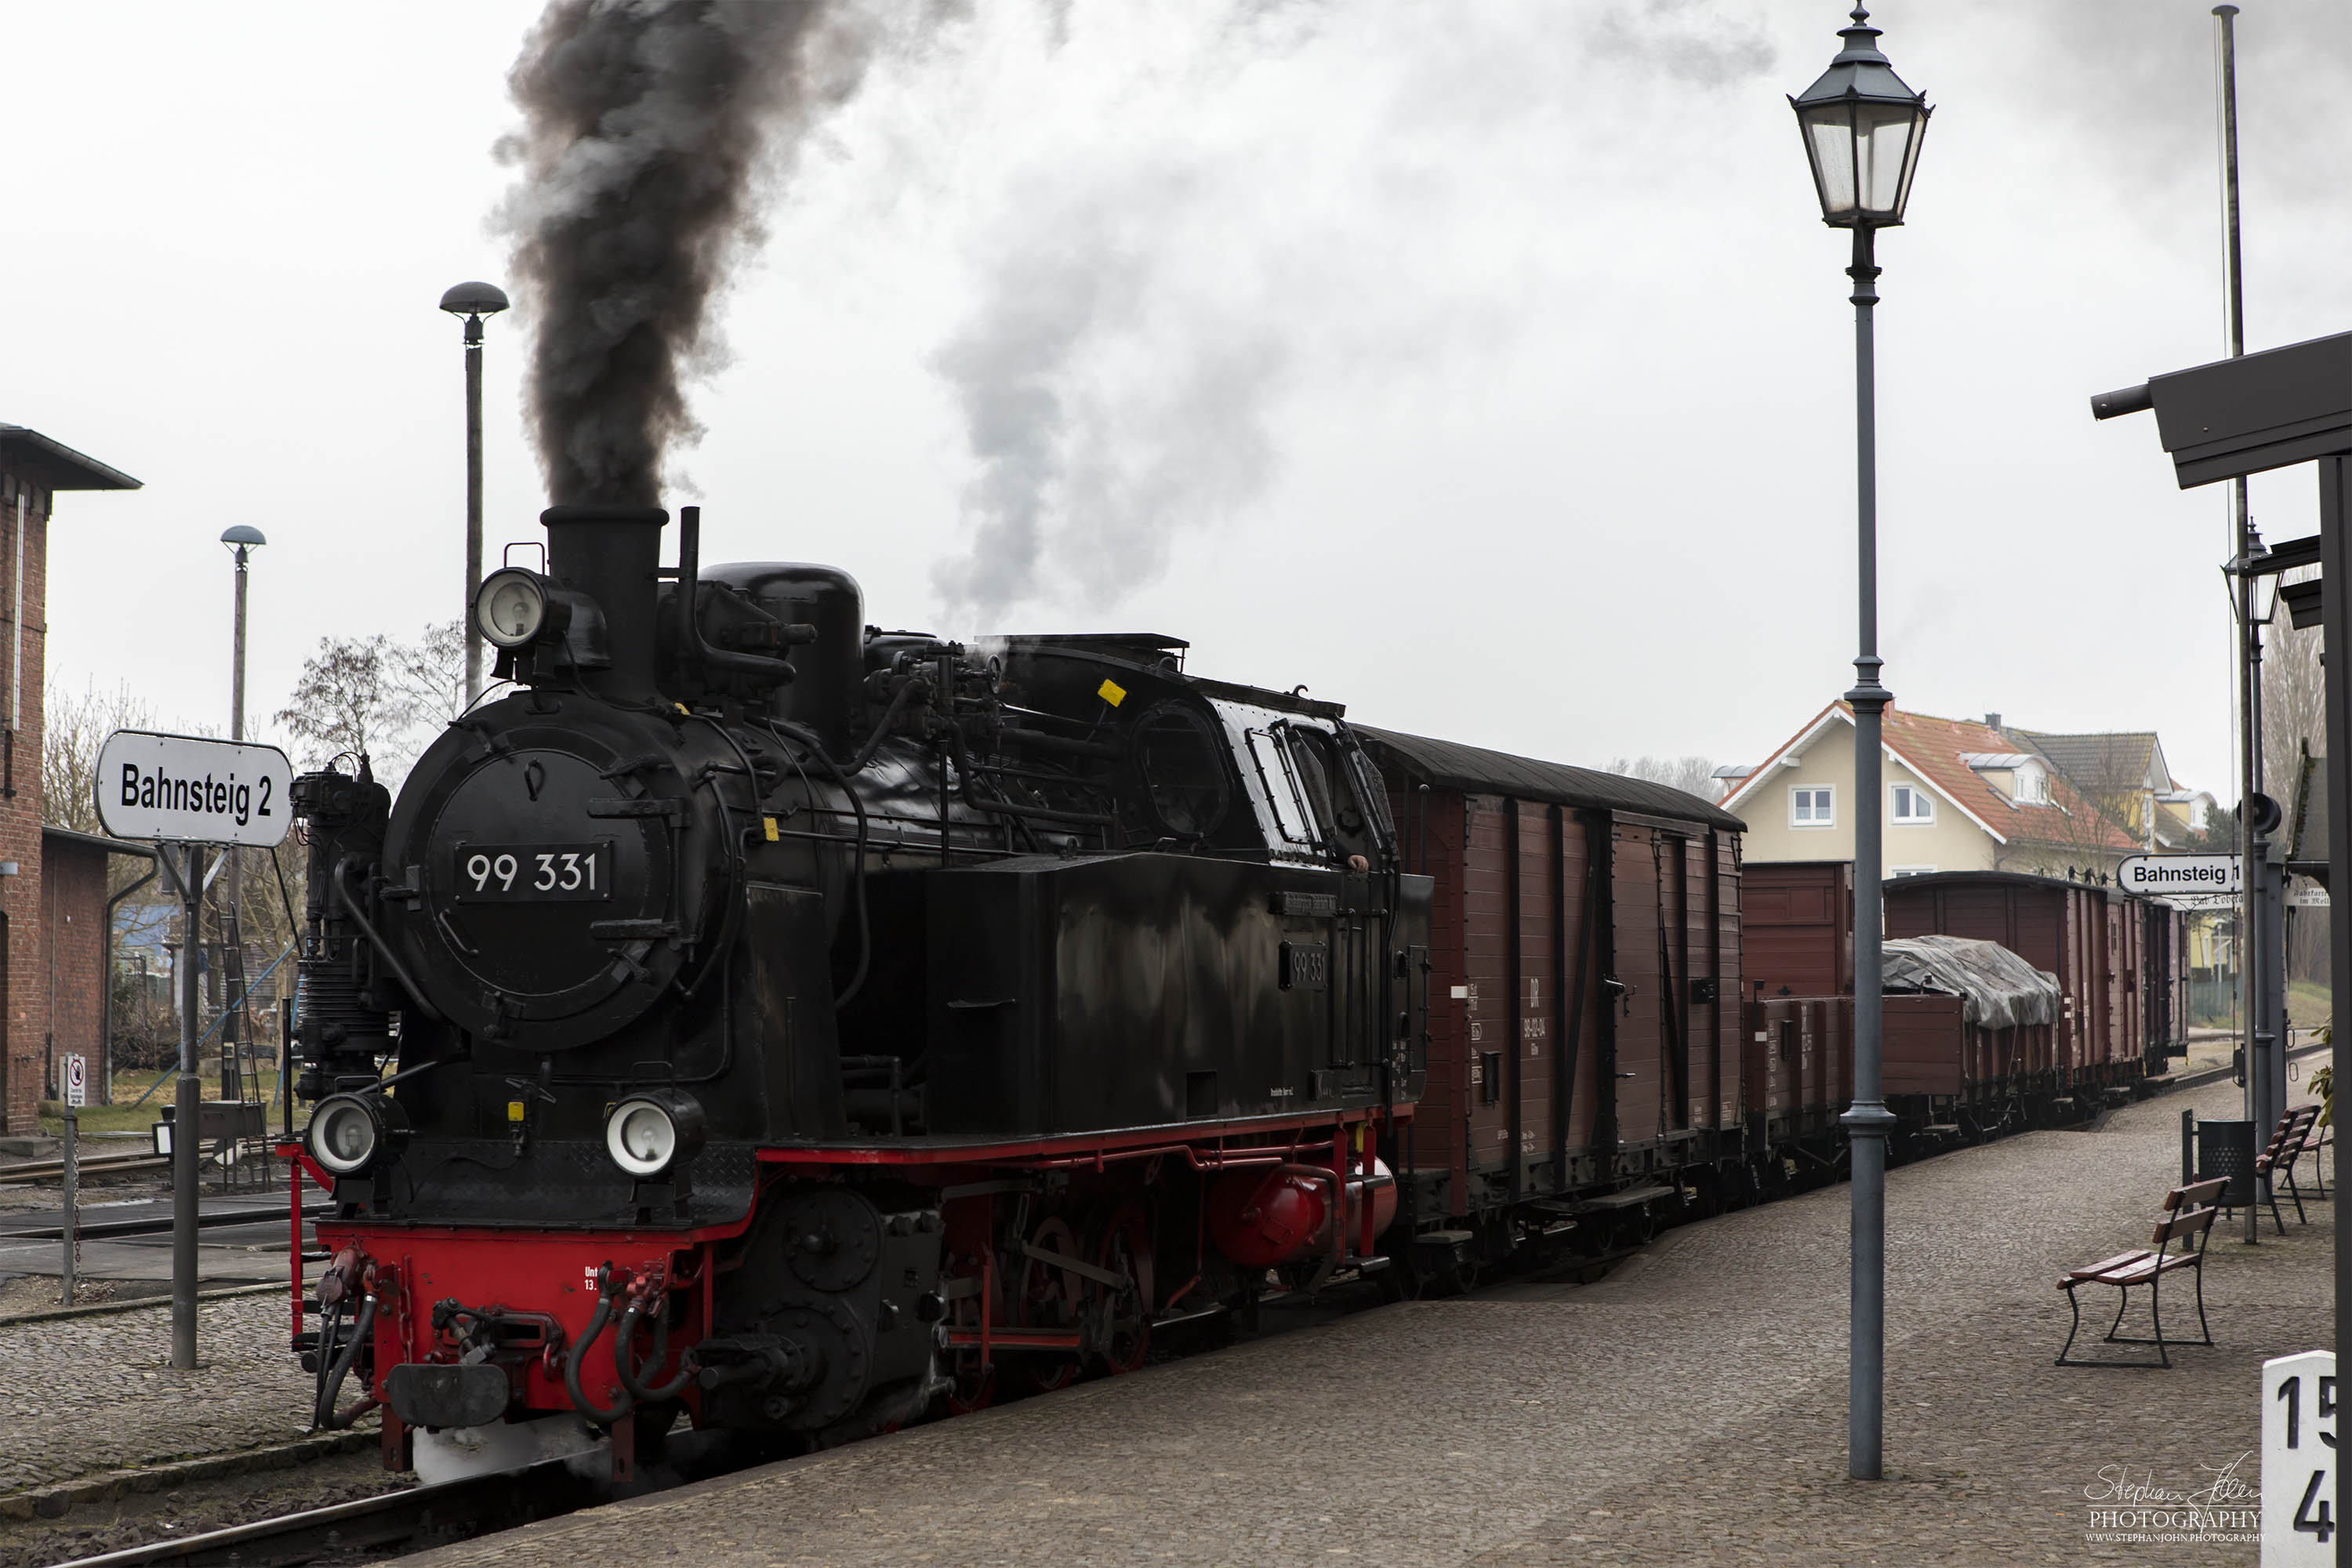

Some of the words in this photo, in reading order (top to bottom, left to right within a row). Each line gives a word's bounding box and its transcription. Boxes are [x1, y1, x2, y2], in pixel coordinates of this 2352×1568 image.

[121, 763, 251, 826] Bahnsteig
[259, 775, 272, 817] 2
[466, 854, 517, 891] 99
[534, 853, 596, 891] 331
[2133, 864, 2226, 884] Bahnsteig
[2233, 865, 2241, 880] 1
[2213, 895, 2244, 905] Dobera
[1294, 951, 1307, 982] 99
[1310, 953, 1326, 982] 331
[1530, 978, 1540, 1008] DR
[2278, 1376, 2336, 1450] 15
[2293, 1470, 2336, 1544] 4
